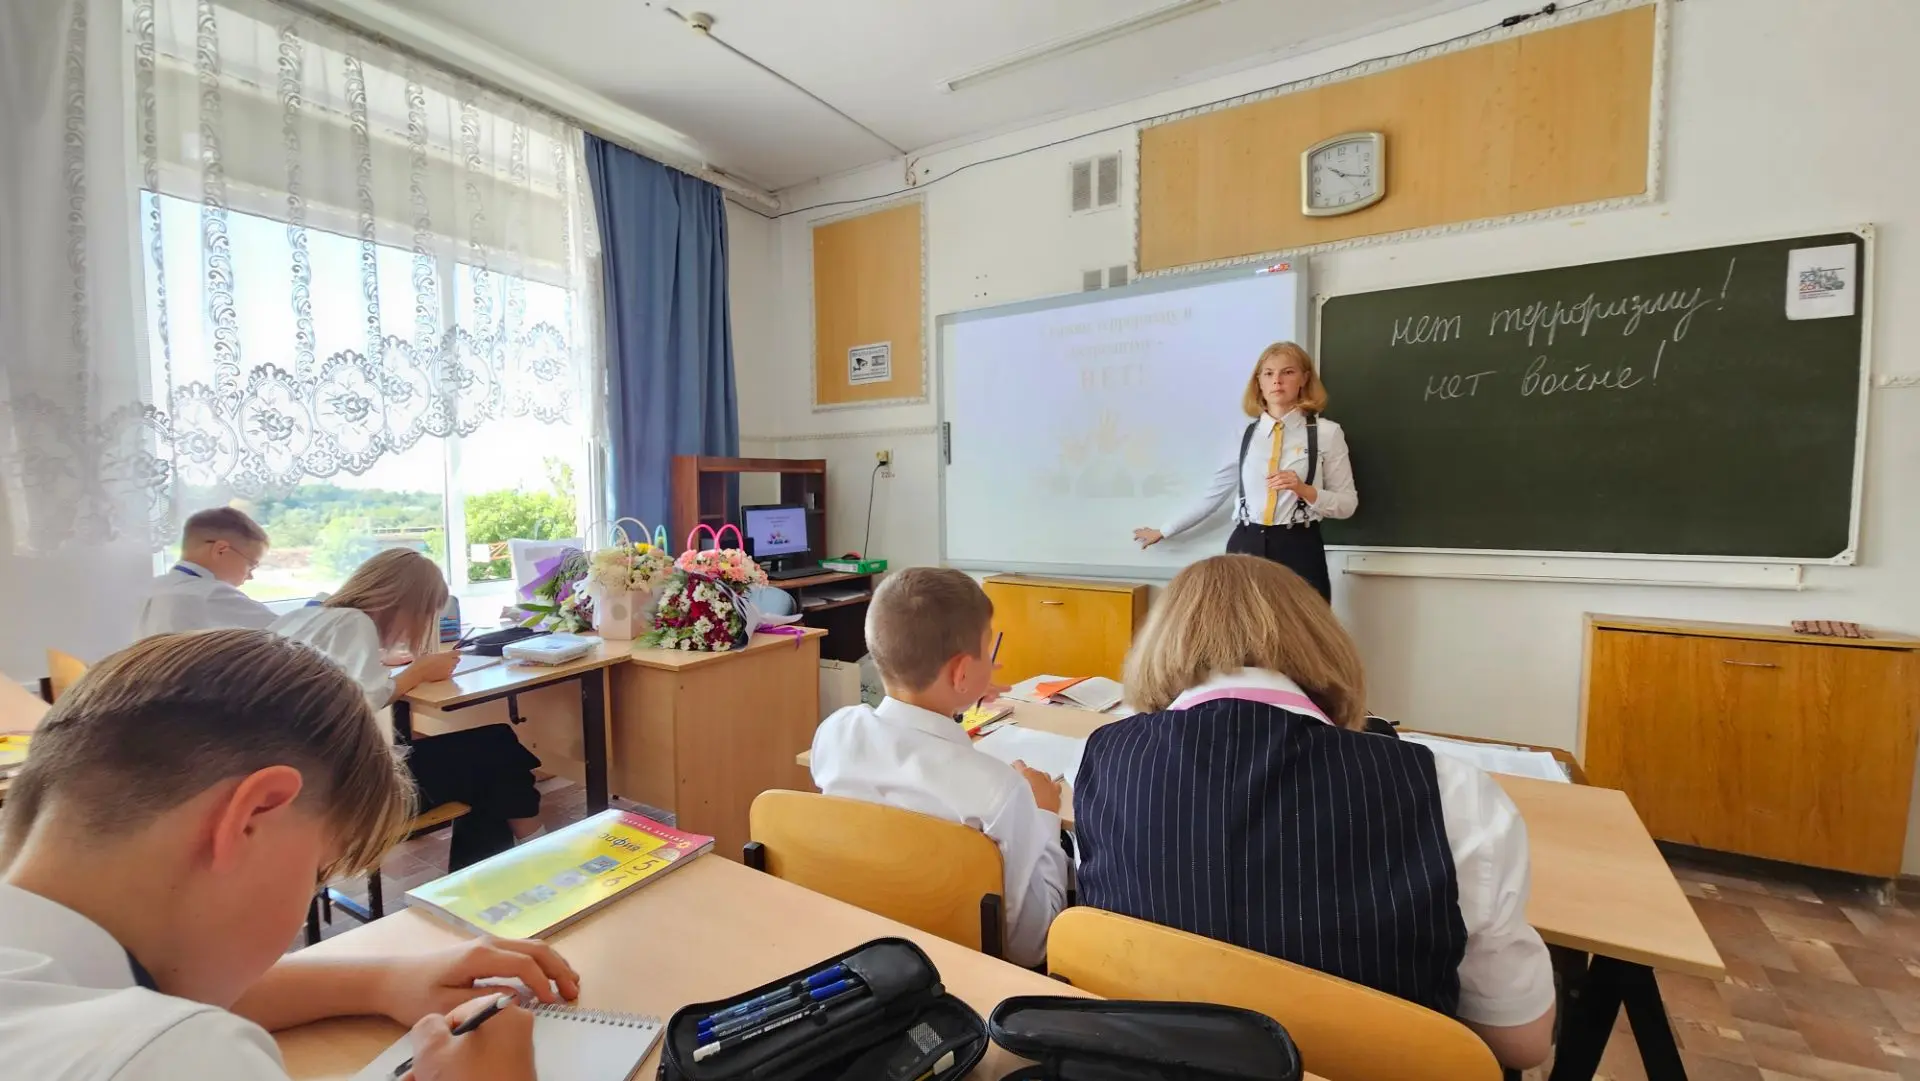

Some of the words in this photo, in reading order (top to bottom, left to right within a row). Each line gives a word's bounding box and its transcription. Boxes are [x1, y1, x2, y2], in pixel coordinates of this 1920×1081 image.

[1337, 146, 1346, 157] 12
[1391, 313, 1461, 347] нет
[1424, 370, 1498, 402] нет
[1520, 340, 1667, 397] войне!
